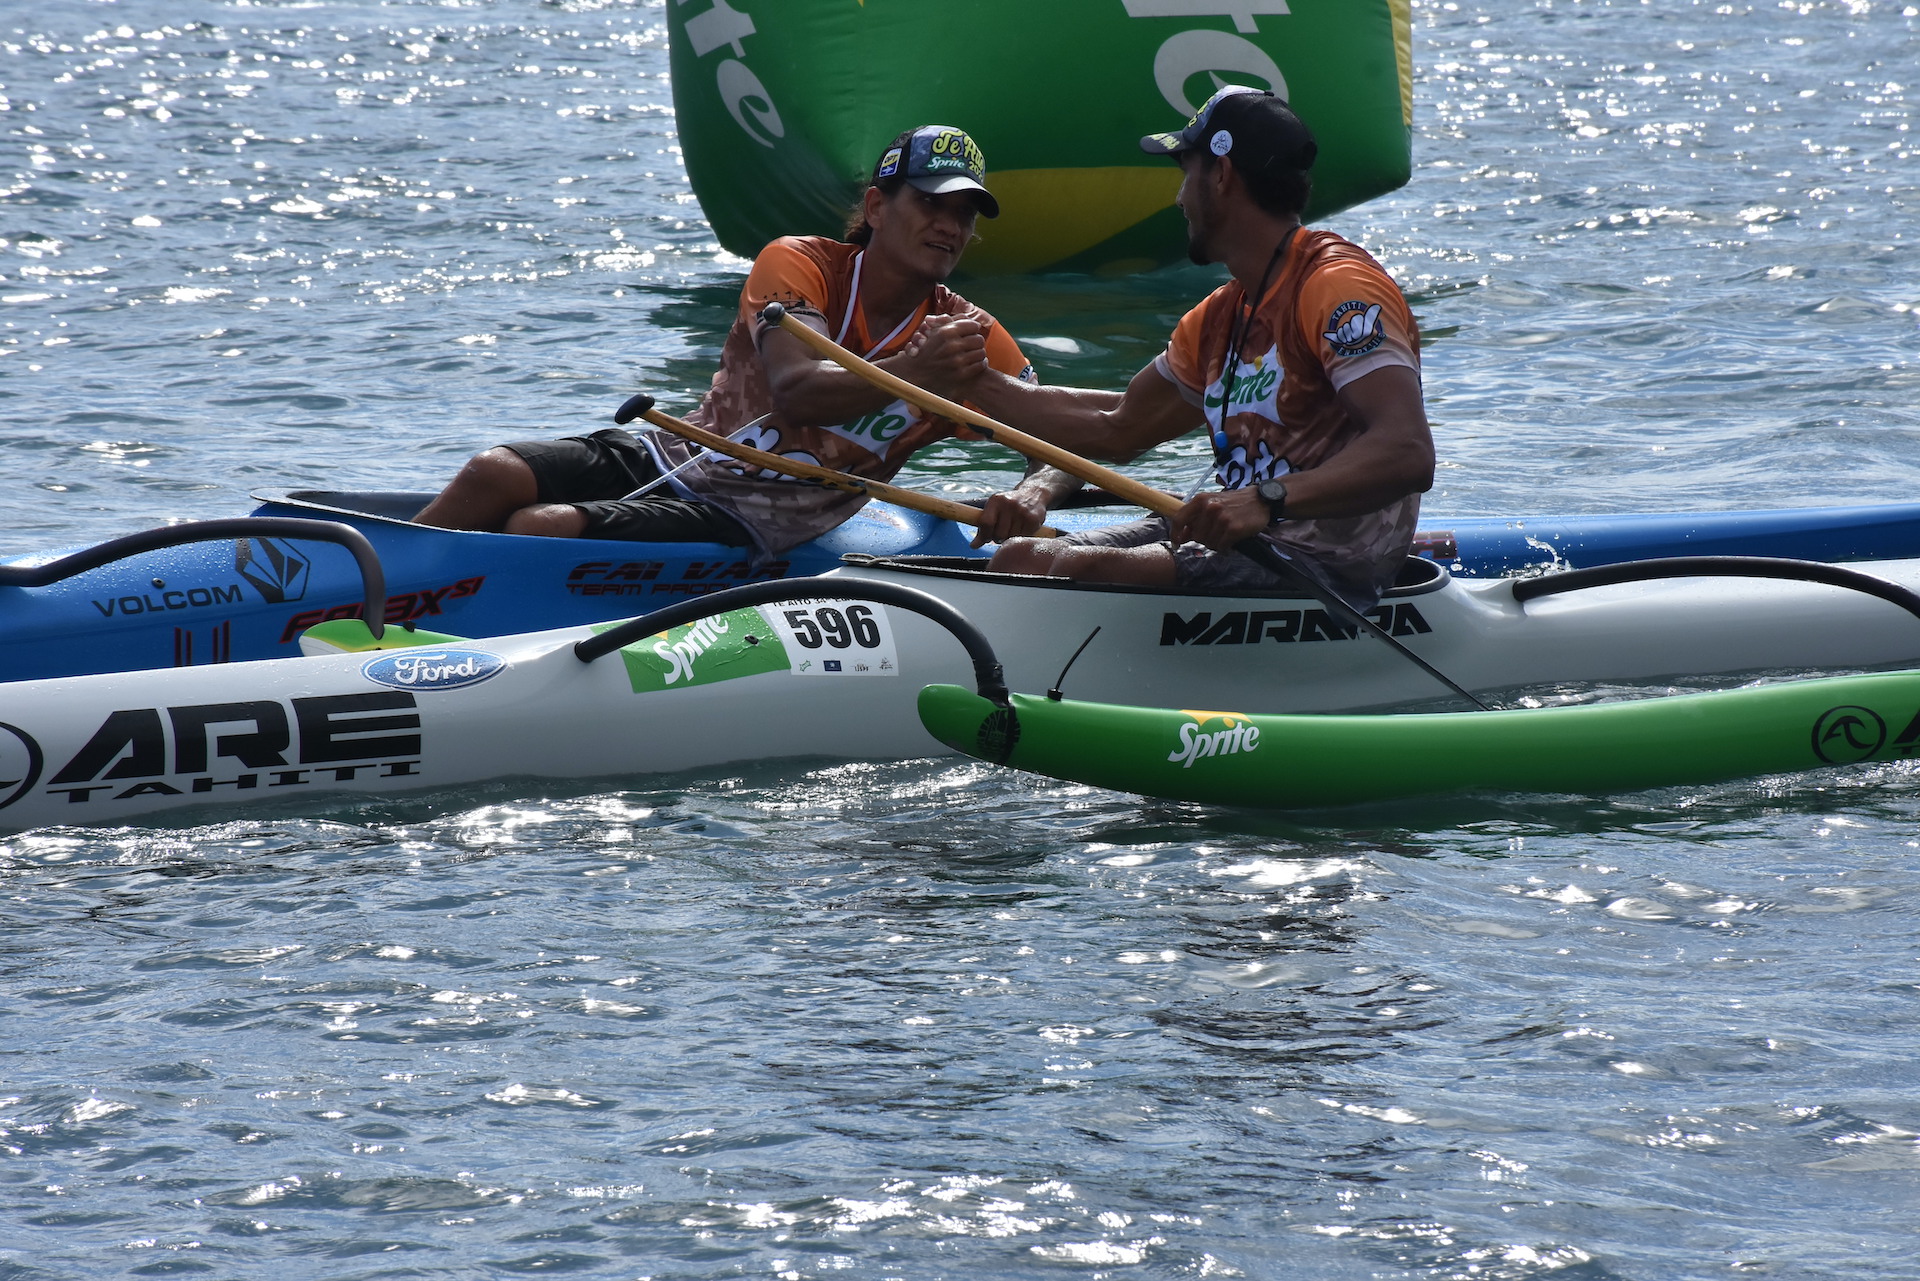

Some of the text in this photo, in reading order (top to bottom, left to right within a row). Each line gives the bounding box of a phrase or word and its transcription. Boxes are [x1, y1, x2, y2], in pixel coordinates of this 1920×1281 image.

[932, 130, 963, 154] Te
[927, 156, 965, 169] Sprite
[1332, 302, 1362, 321] TAHITI
[567, 562, 665, 580] FAI
[91, 584, 243, 617] VOLCOM
[565, 583, 641, 596] TEAM
[783, 605, 881, 649] 596
[653, 613, 729, 685] Sprite
[394, 654, 482, 684] Ford
[46, 690, 421, 785] ARE
[1167, 721, 1260, 769] Sprite
[46, 760, 421, 803] TAHITI
